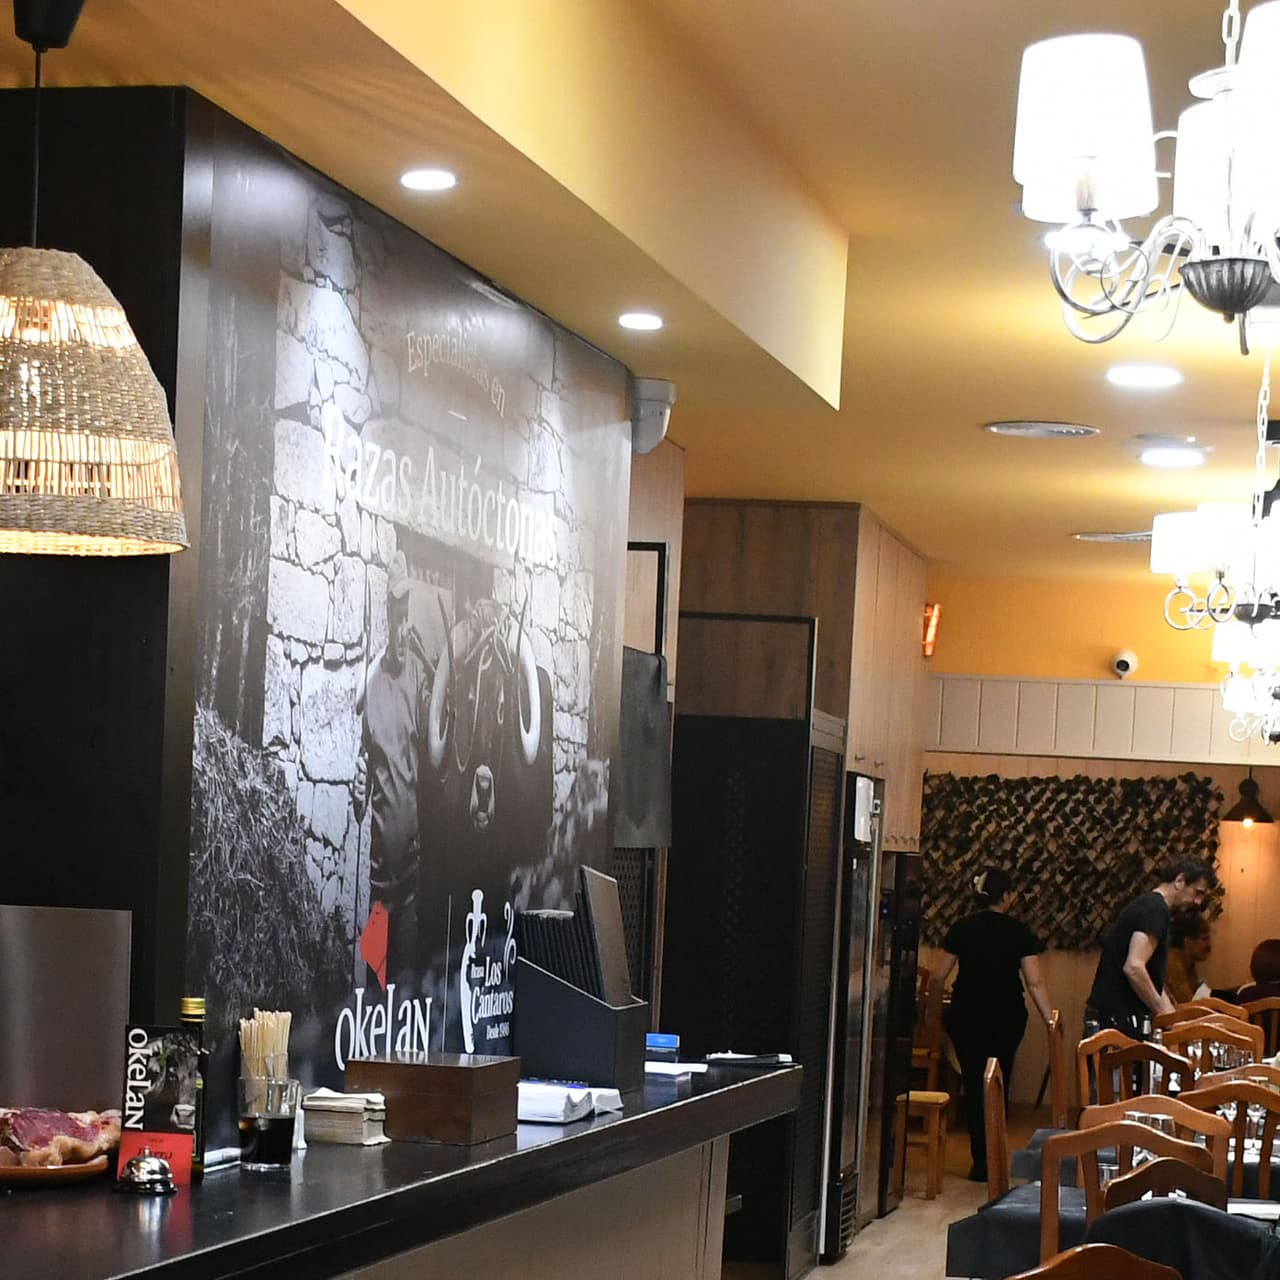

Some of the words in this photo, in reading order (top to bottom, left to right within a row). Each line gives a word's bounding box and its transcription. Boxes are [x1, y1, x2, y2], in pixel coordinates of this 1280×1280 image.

[322, 402, 413, 516] Razas
[421, 446, 558, 569] Autóctonas
[485, 956, 502, 987] Los
[471, 986, 514, 1025] Cántaros
